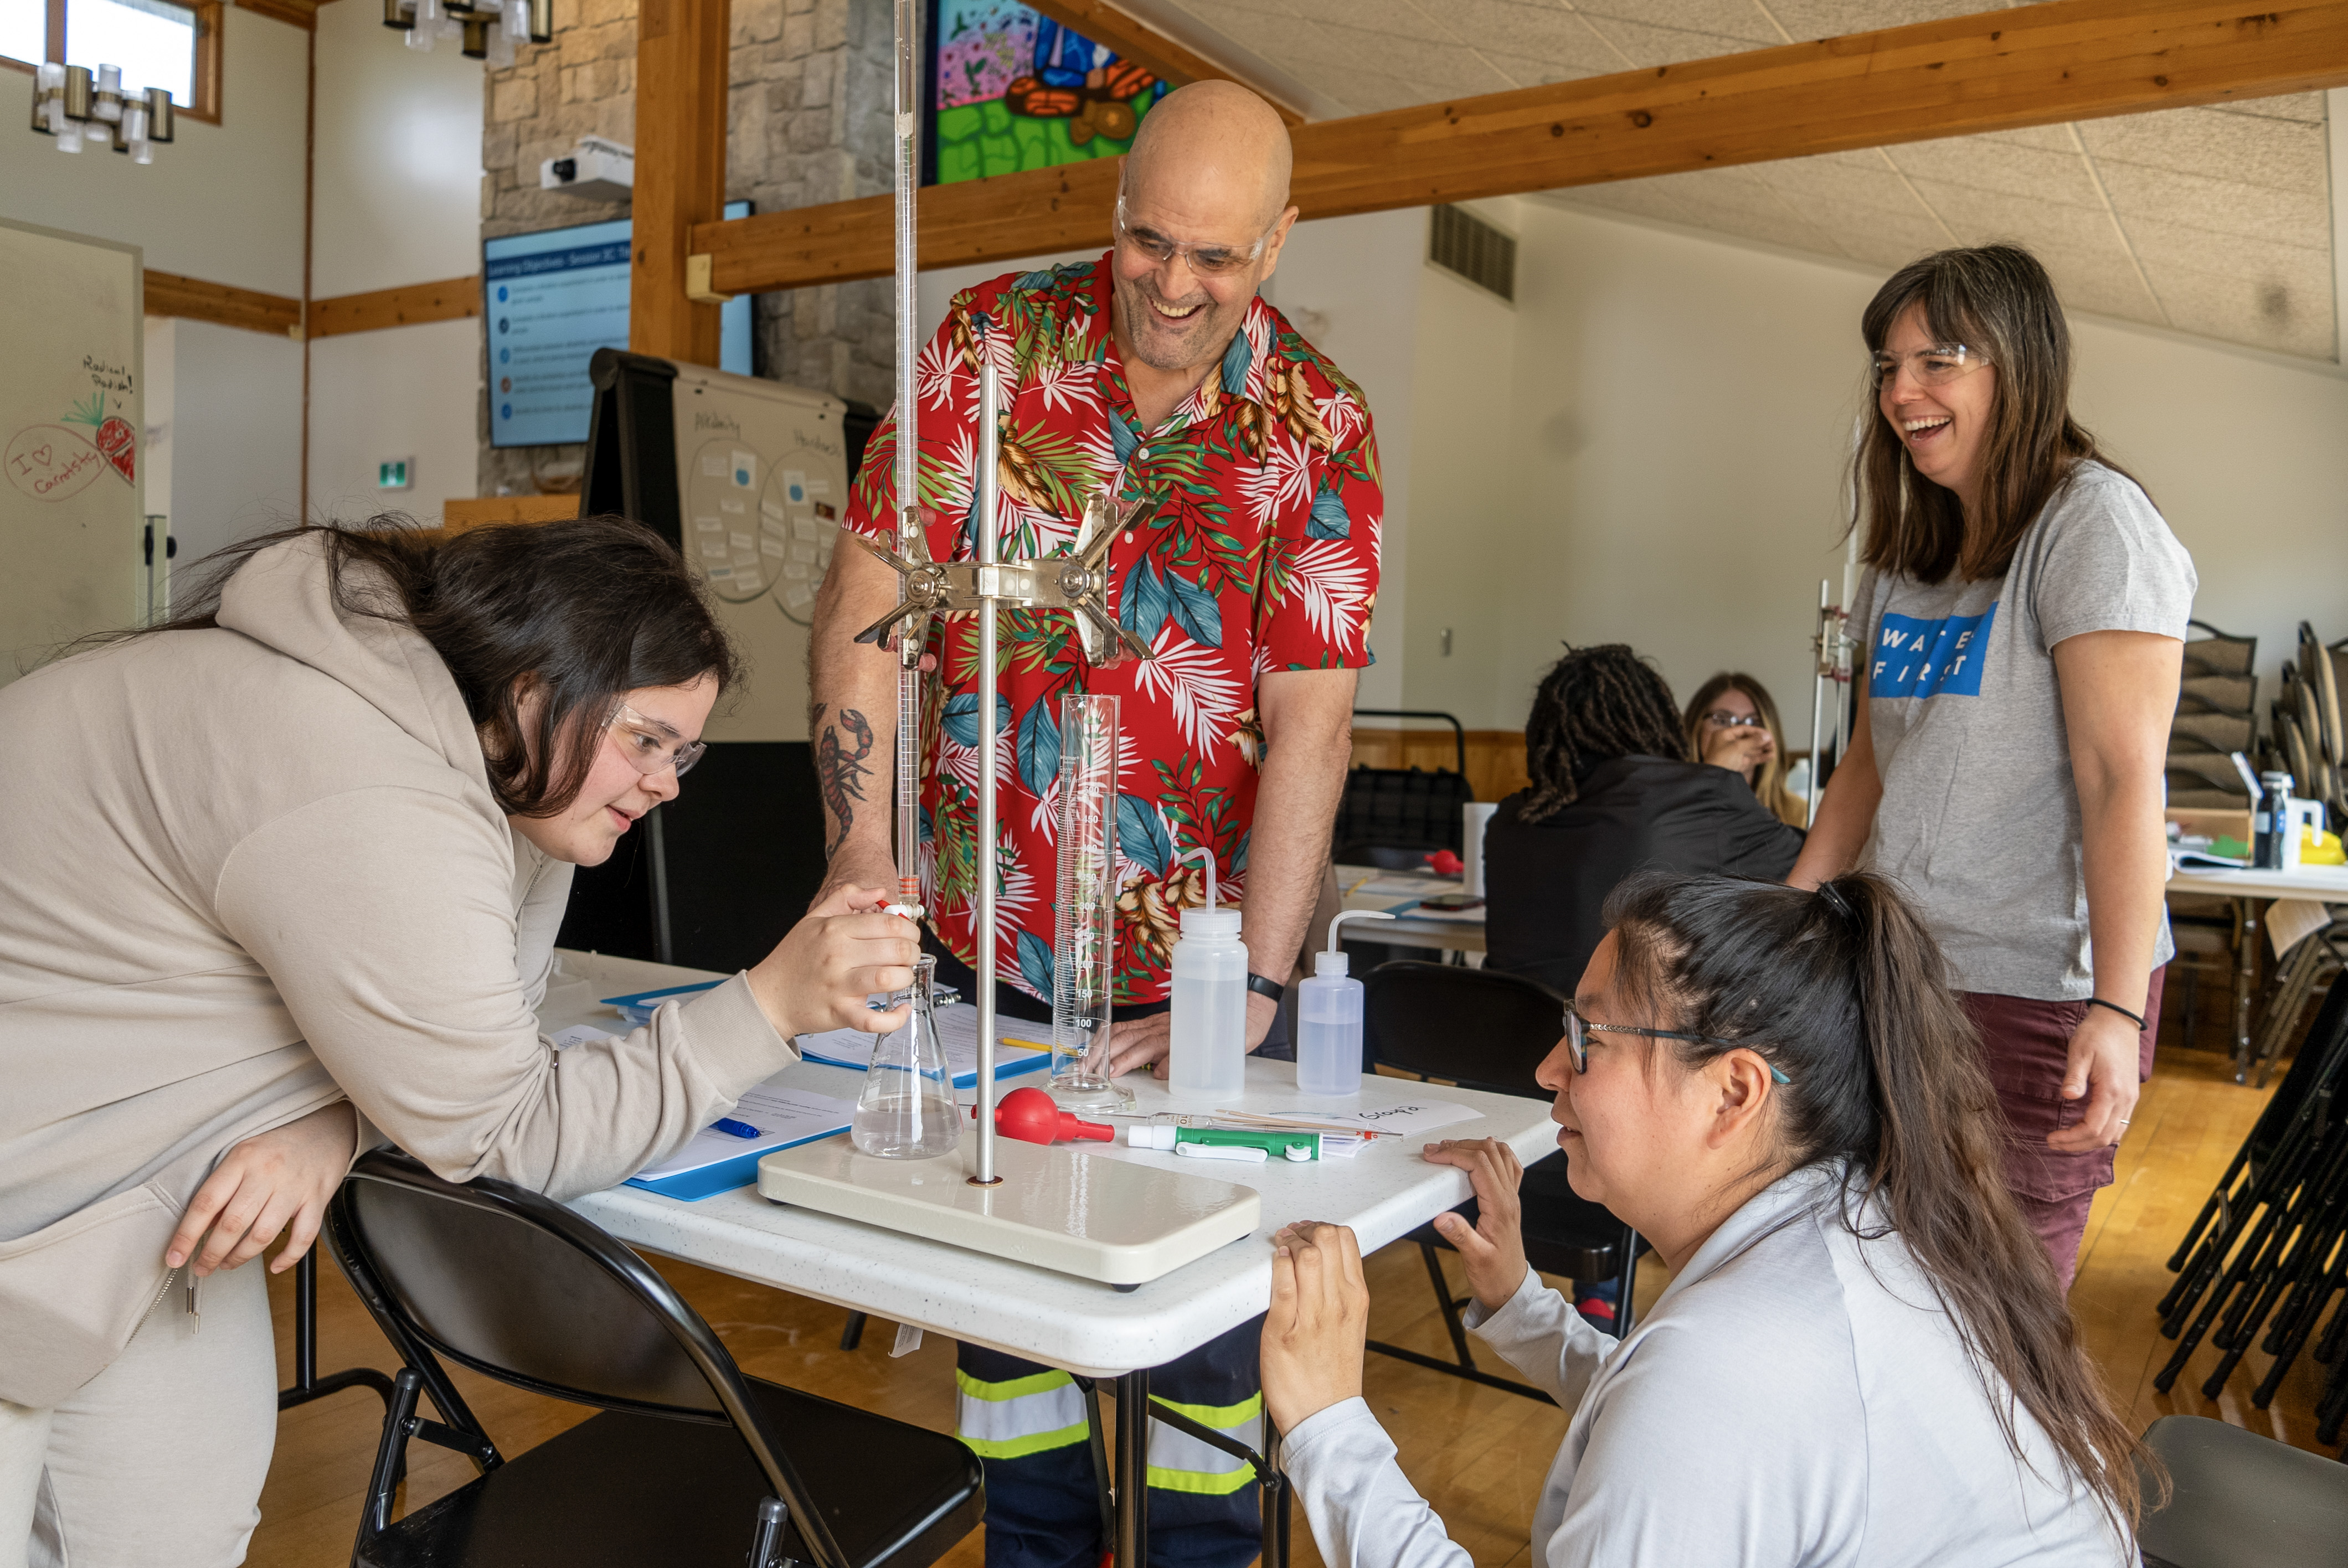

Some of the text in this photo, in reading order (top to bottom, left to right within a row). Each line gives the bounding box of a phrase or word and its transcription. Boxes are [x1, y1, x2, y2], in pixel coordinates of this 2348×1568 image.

[1882, 628, 1974, 652] WAE
[1079, 932, 1095, 941] 50
[1077, 990, 1093, 998] 150
[1075, 1019, 1091, 1028] 100
[1180, 1116, 1188, 1125] 10
